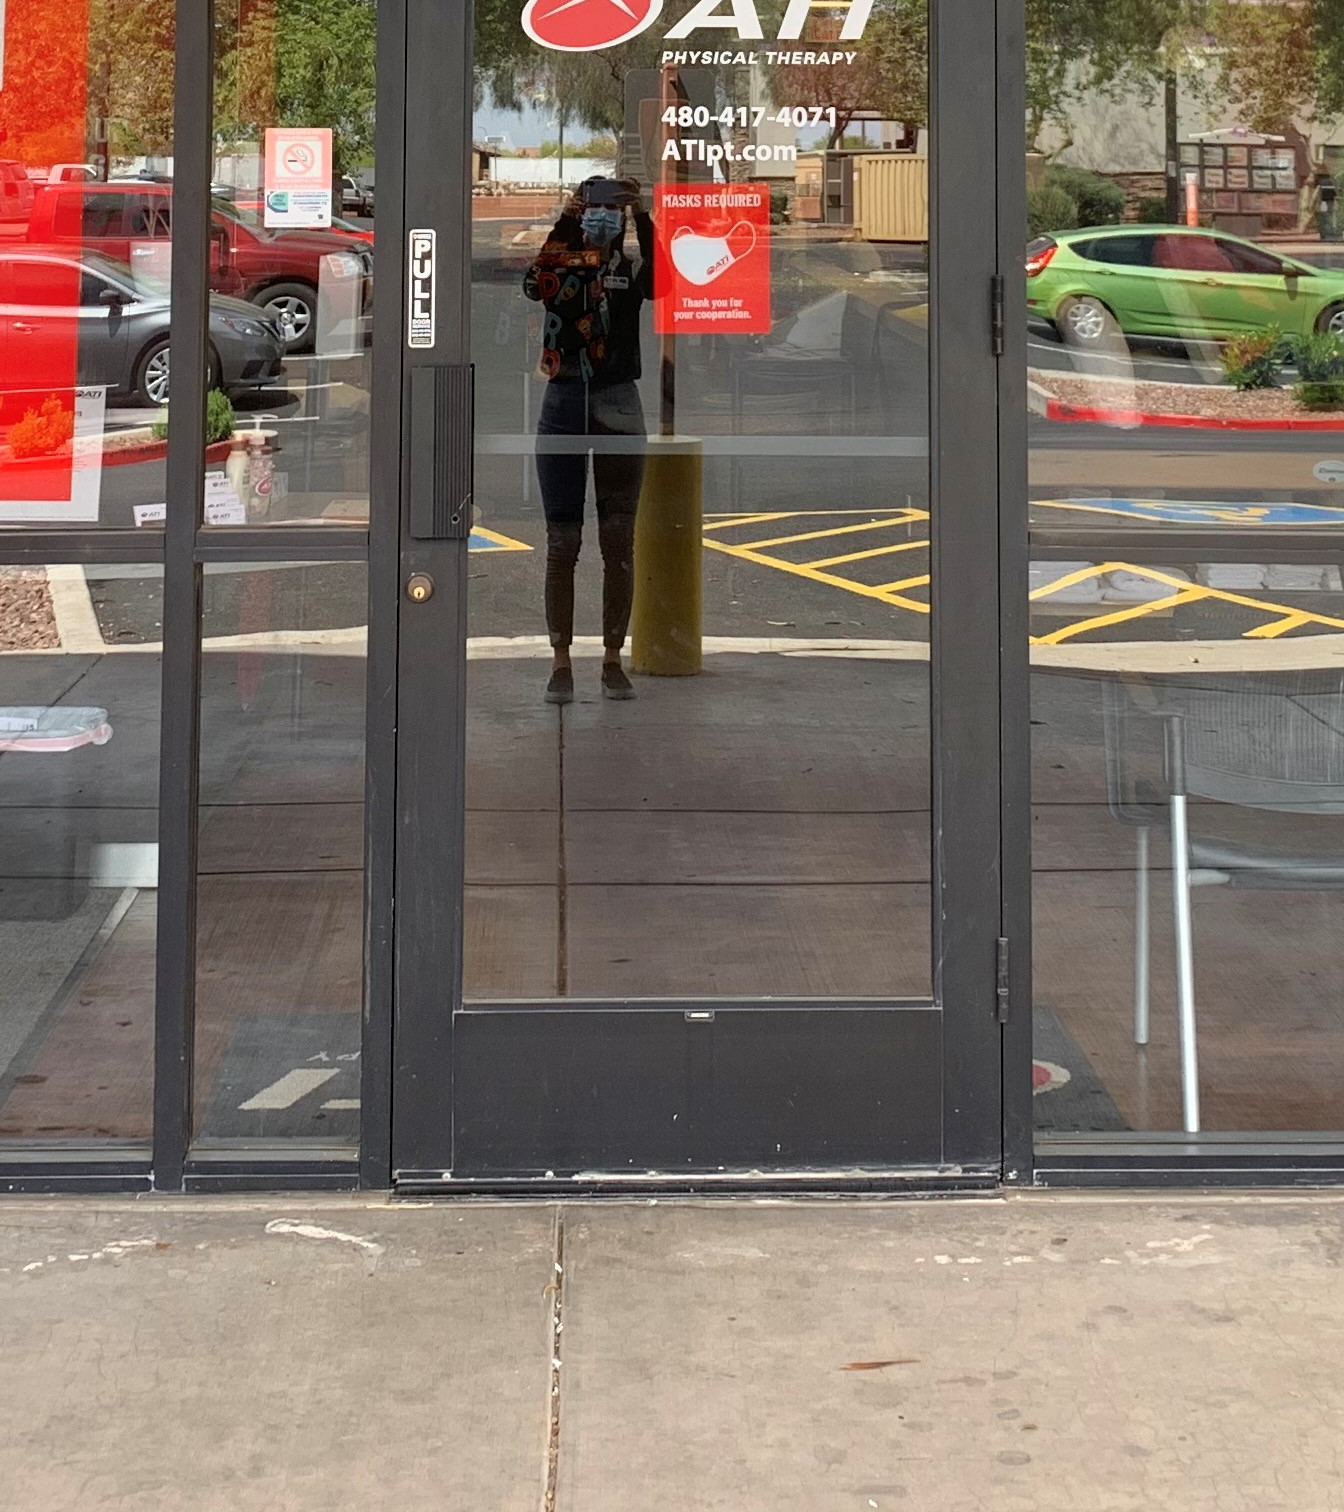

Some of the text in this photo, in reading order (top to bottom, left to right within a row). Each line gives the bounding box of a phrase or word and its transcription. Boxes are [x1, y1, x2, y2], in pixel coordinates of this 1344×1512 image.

[661, 50, 857, 66] PHYSICAL THERAPY
[661, 105, 836, 128] 480-417-4071
[661, 138, 797, 166] ATIpt.com
[662, 194, 762, 208] MASKS REQUIRED
[413, 239, 432, 319] PULL
[682, 297, 744, 309] Thank you for
[673, 309, 752, 321] your cooperation.
[83, 390, 102, 398] ATI
